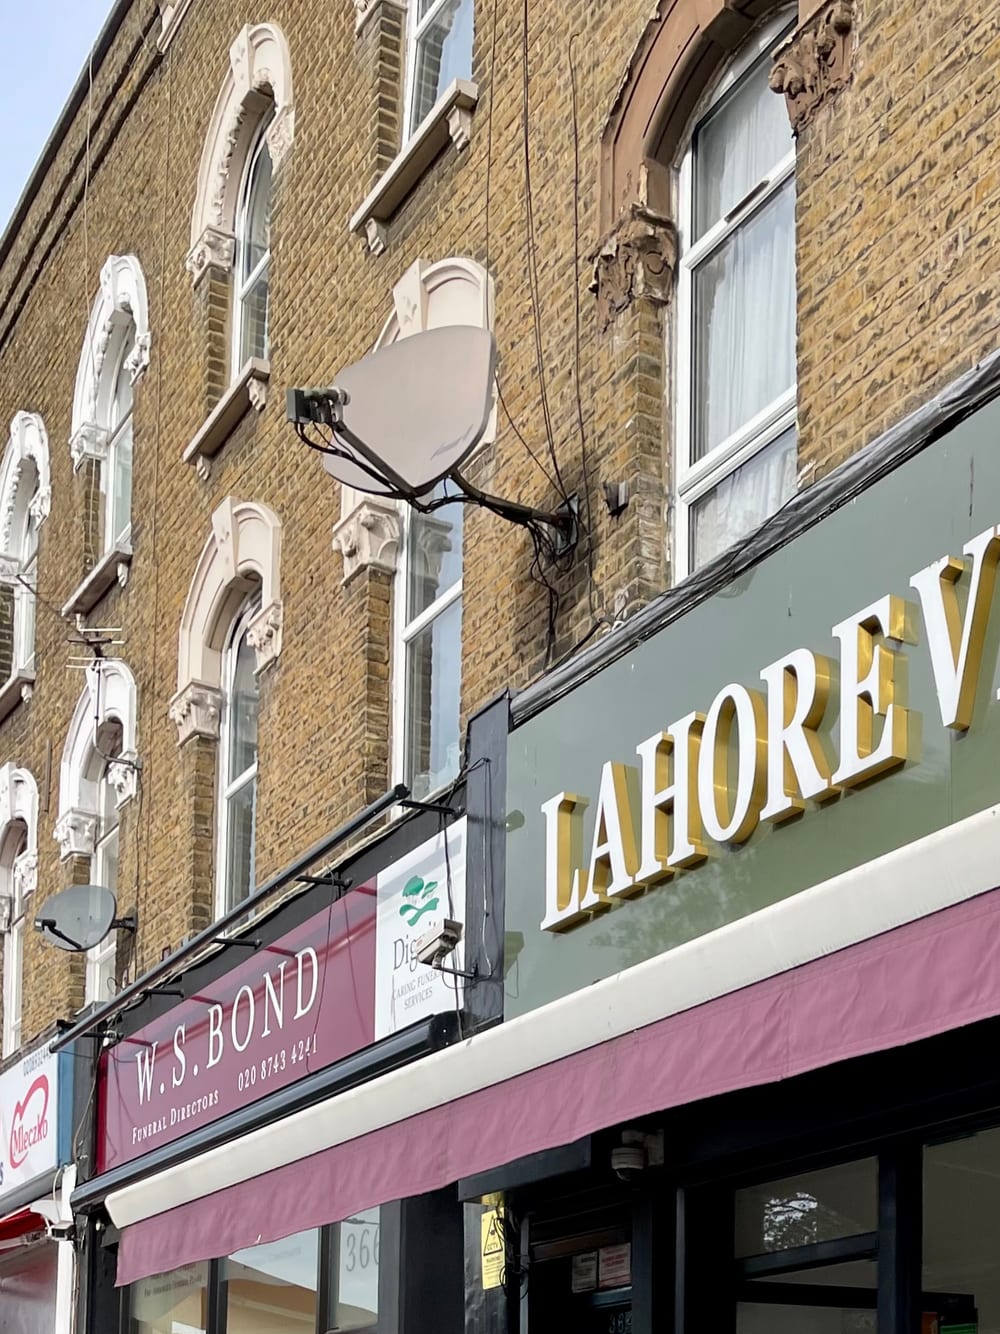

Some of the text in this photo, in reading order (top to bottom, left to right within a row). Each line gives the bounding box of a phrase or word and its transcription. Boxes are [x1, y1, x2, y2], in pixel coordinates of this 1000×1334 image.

[540, 592, 912, 933] LAHORE
[404, 986, 433, 1009] SERVICES
[238, 1065, 257, 1092] 020
[260, 1052, 286, 1080] 8743
